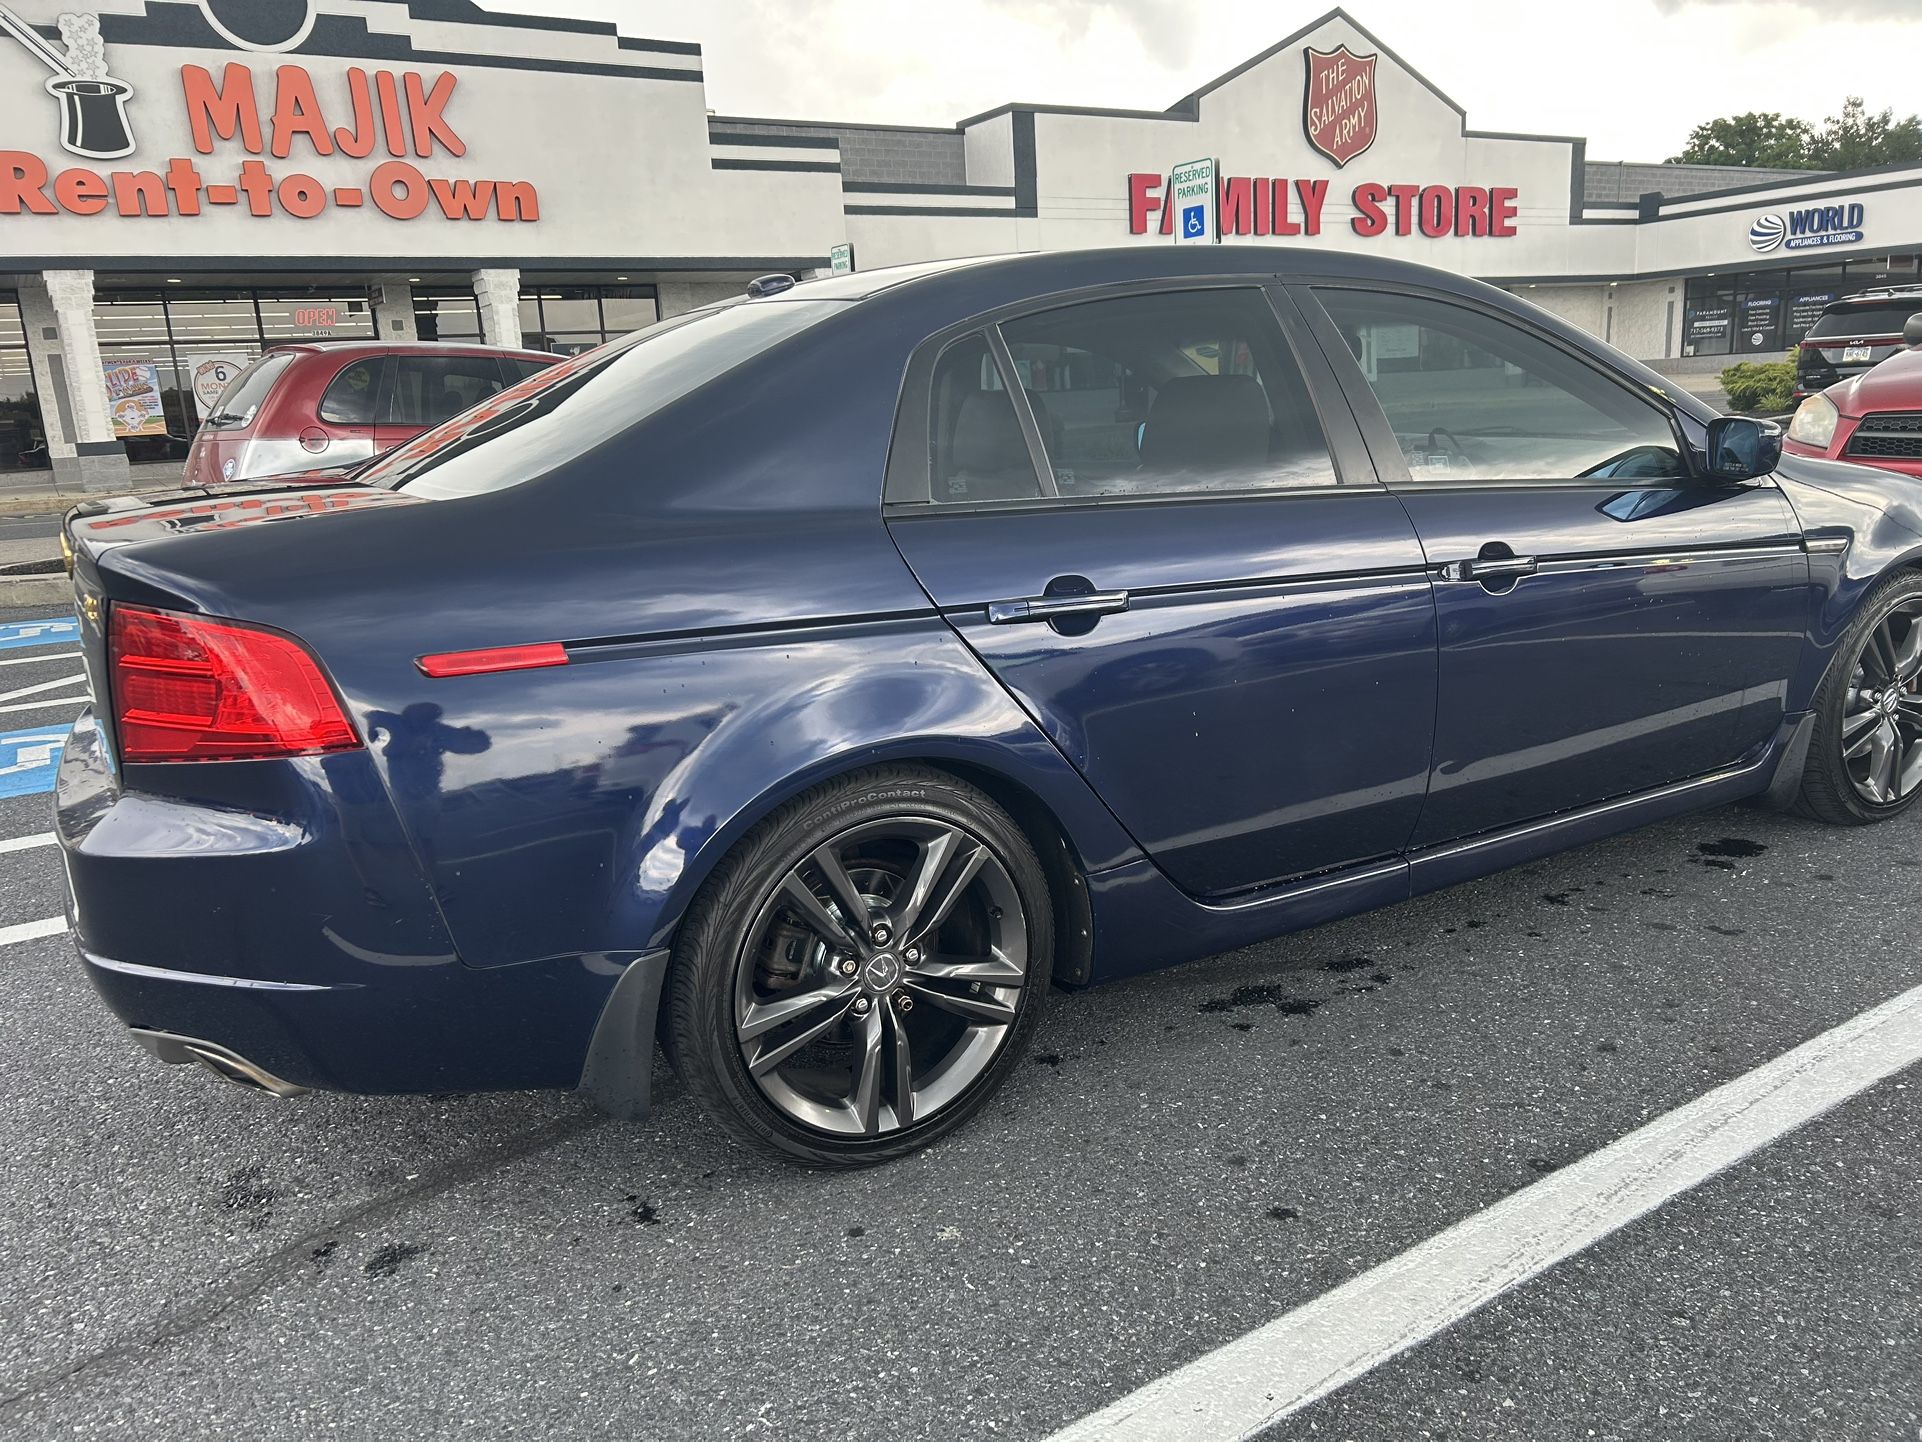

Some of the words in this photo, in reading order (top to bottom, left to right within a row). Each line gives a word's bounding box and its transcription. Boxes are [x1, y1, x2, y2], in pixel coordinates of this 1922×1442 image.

[1320, 59, 1347, 94] THE
[181, 62, 466, 158] MAJIK
[1311, 66, 1369, 135] SALVATION
[1333, 101, 1367, 150] ARMY
[0, 150, 539, 221] Rent-to-Own
[1174, 166, 1211, 184] RESERVED
[1177, 182, 1209, 199] PARKING
[1351, 182, 1518, 238] STORE
[1789, 203, 1864, 236] WORLD
[1790, 237, 1821, 247] APPLIANCES
[1829, 232, 1856, 243] FLOORING
[296, 308, 336, 326] OPEN
[215, 366, 227, 381] 6
[803, 789, 926, 830] ContiProContact
